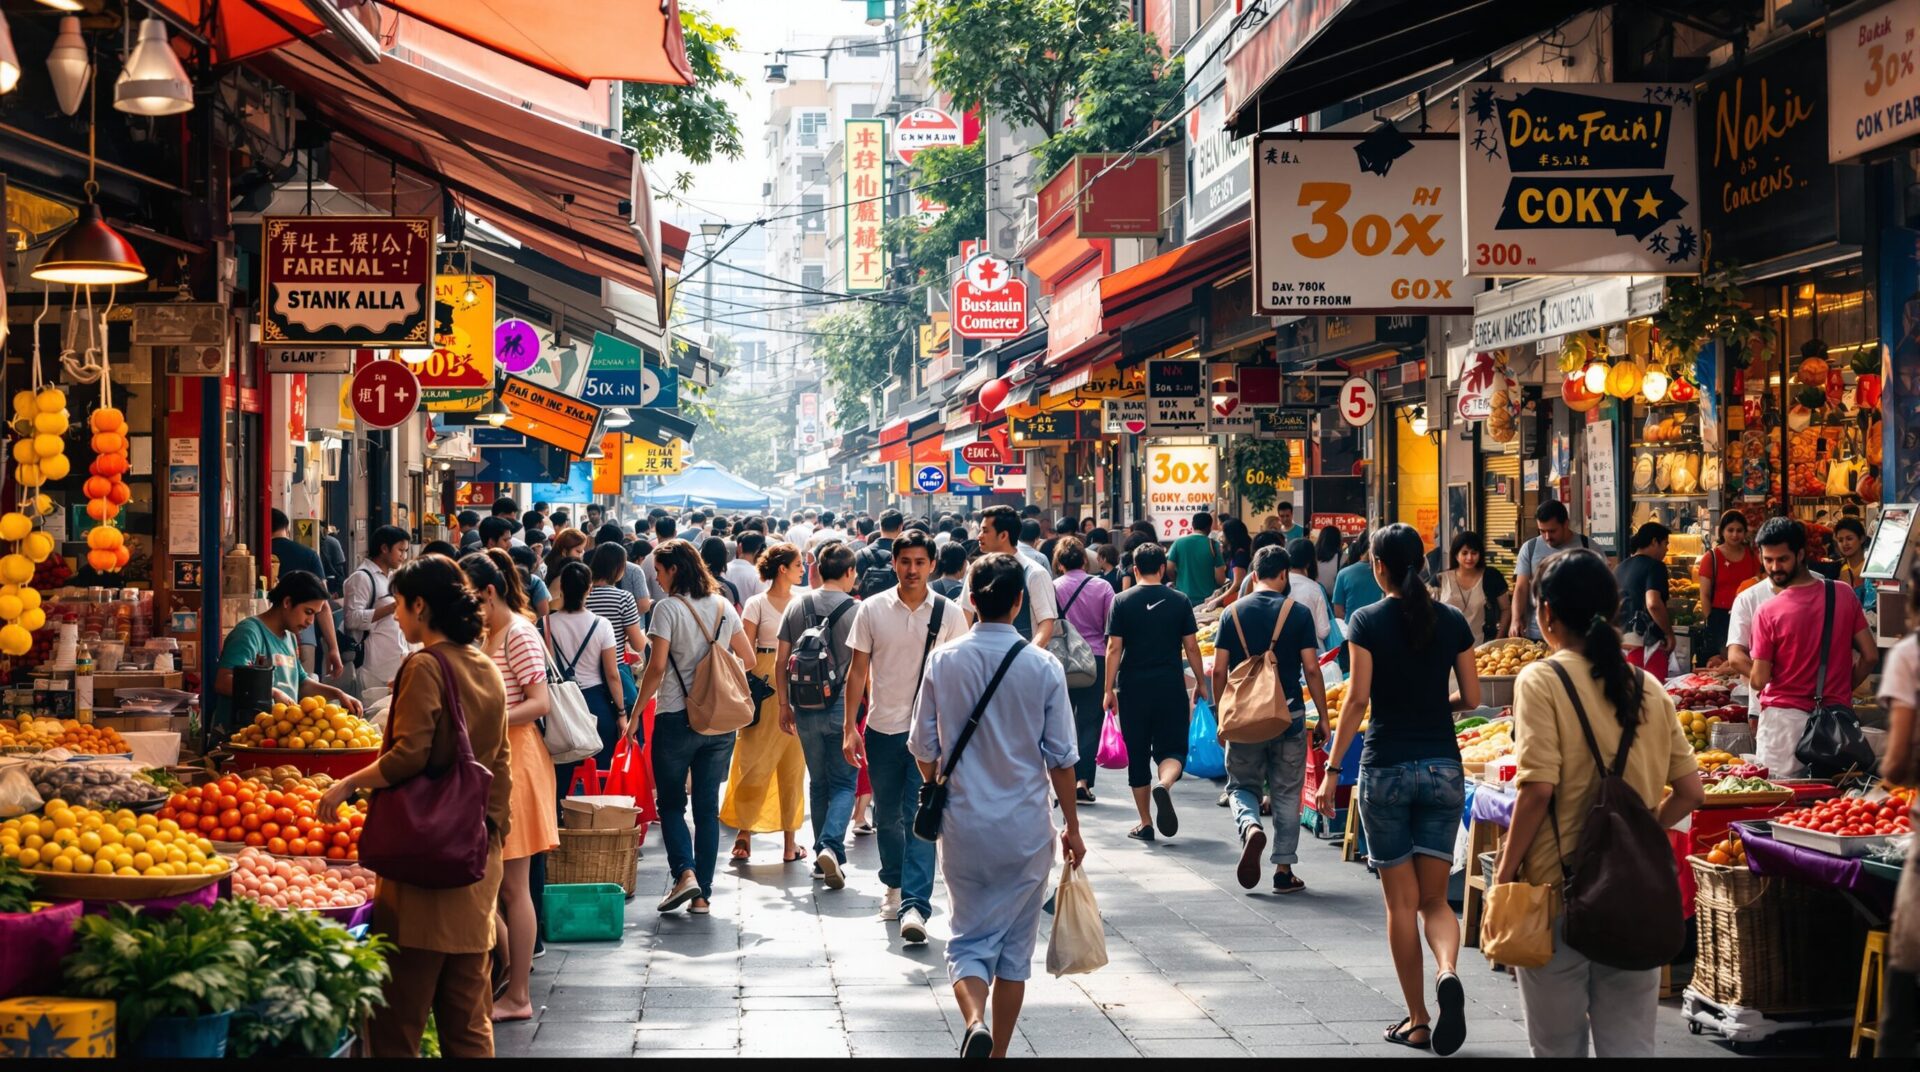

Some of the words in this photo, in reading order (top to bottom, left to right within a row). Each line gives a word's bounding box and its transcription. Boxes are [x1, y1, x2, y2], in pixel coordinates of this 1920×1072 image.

[1856, 110, 1884, 141] COK
[1518, 188, 1630, 224] COKY
[1477, 244, 1522, 266] 300
[282, 257, 384, 276] FARENAL
[287, 290, 351, 310] STANK
[354, 290, 406, 310] ALLA
[1391, 278, 1454, 300] GOX
[1271, 295, 1293, 306] DAY
[1297, 295, 1310, 306] TO
